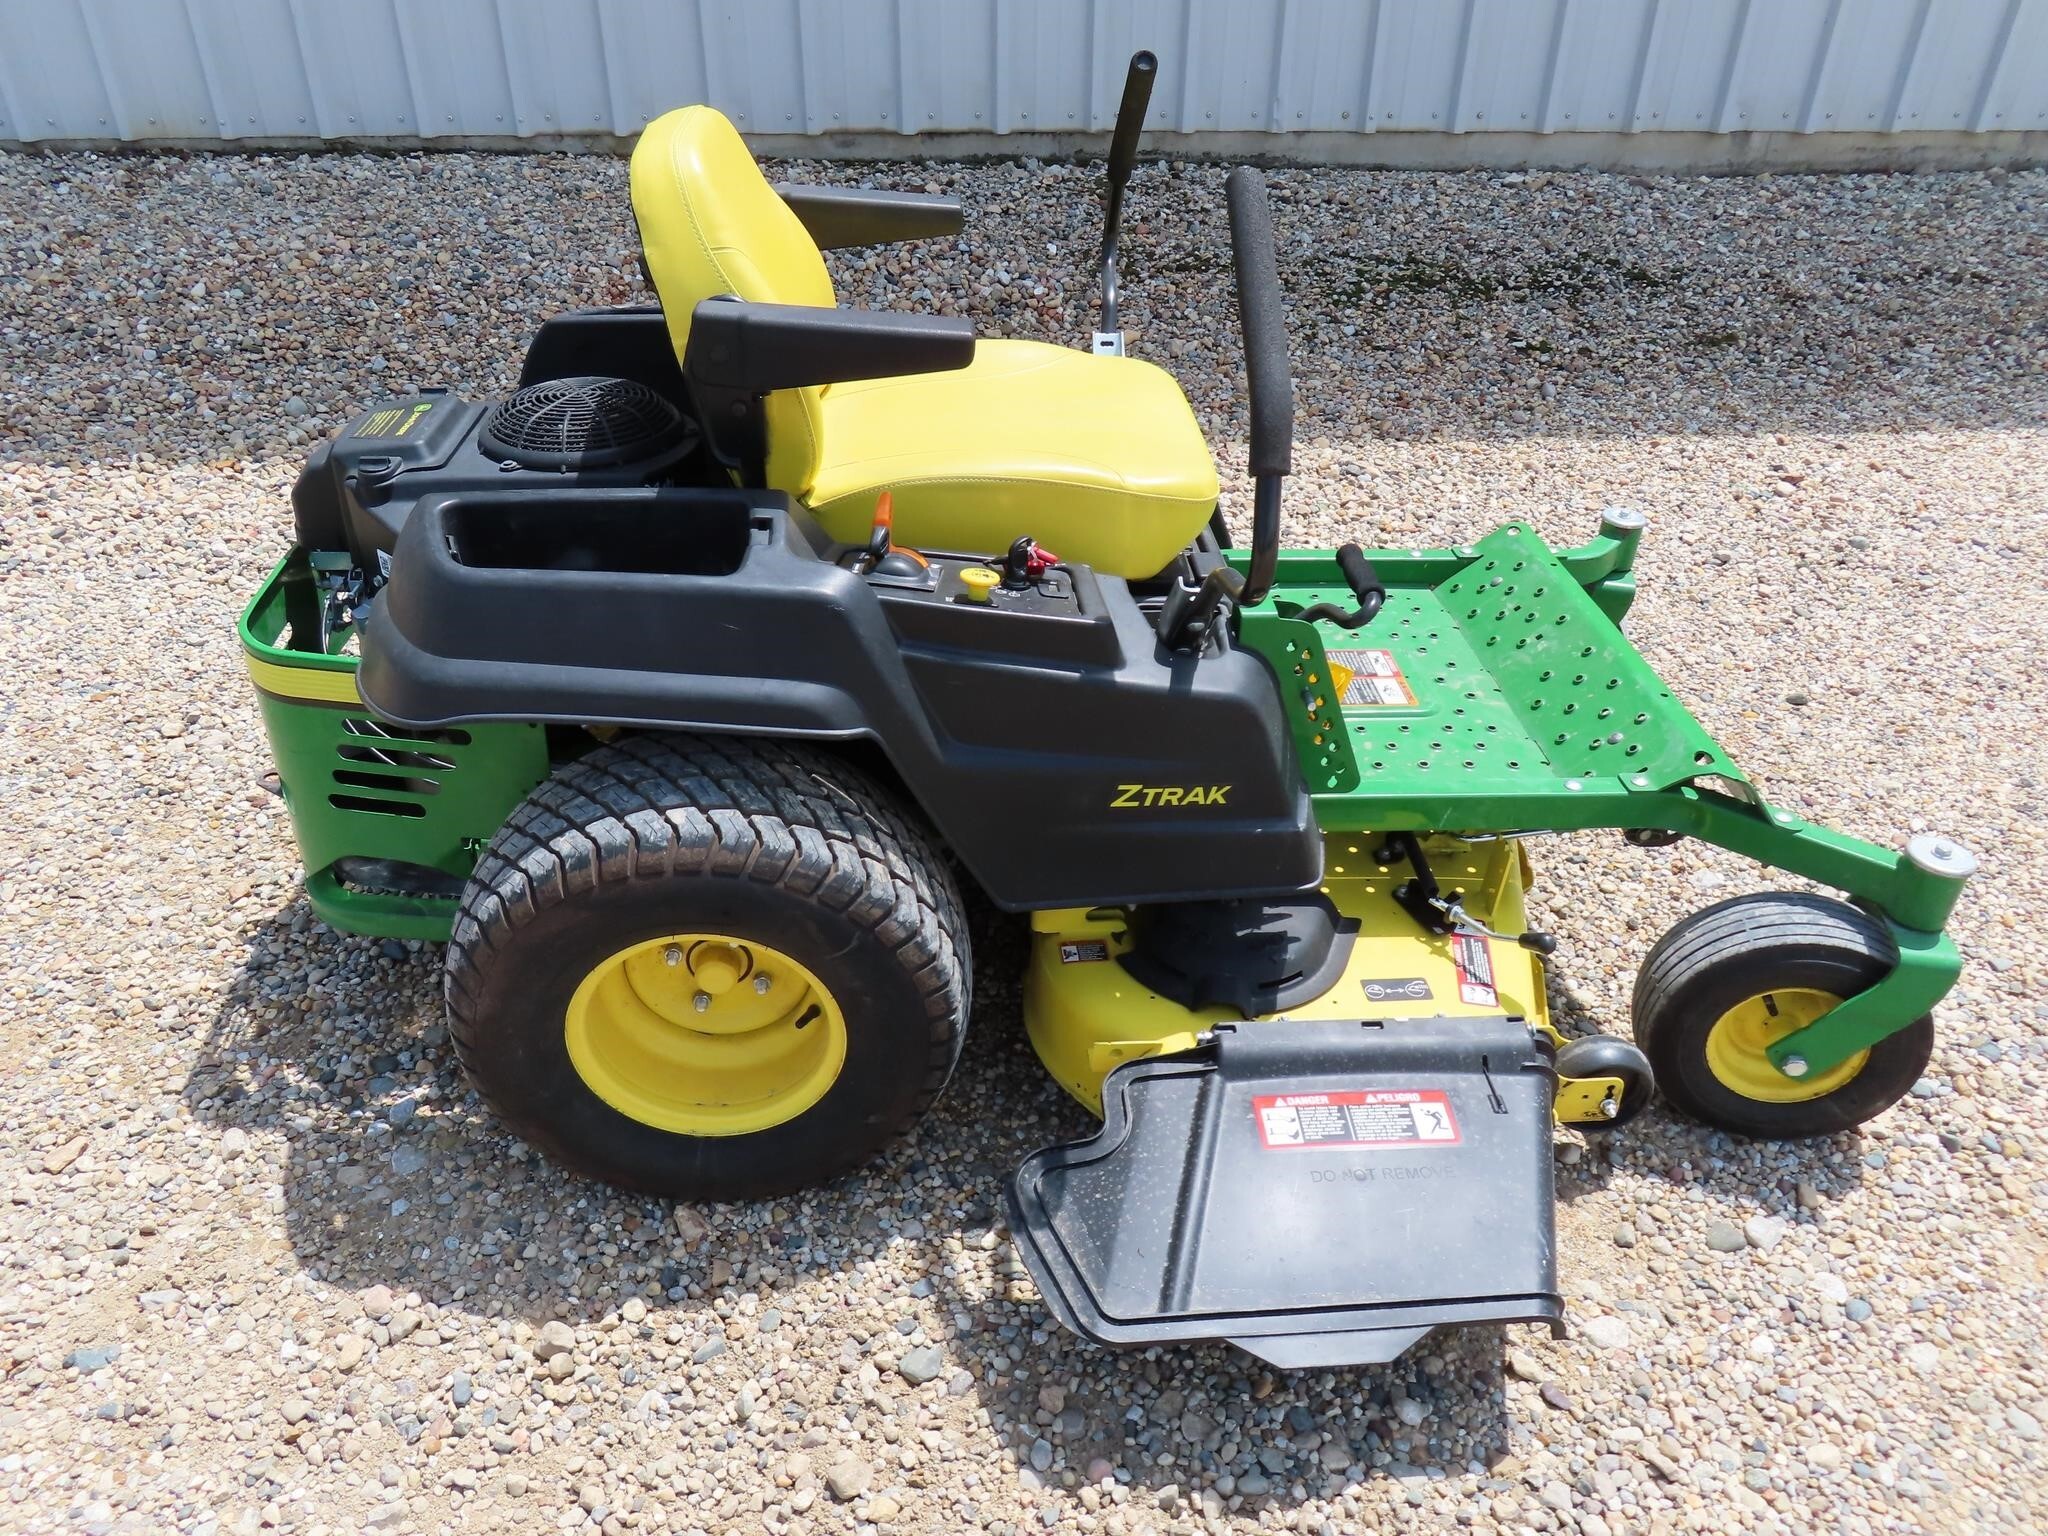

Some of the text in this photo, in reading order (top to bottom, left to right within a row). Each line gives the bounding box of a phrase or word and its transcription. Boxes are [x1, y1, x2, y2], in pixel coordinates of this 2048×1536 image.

[1110, 784, 1232, 807] ZTRAK
[1286, 1095, 1329, 1106] DANGER
[1376, 1092, 1421, 1103] PELIGRO
[1310, 1166, 1457, 1183] DO NOT REMOVE
